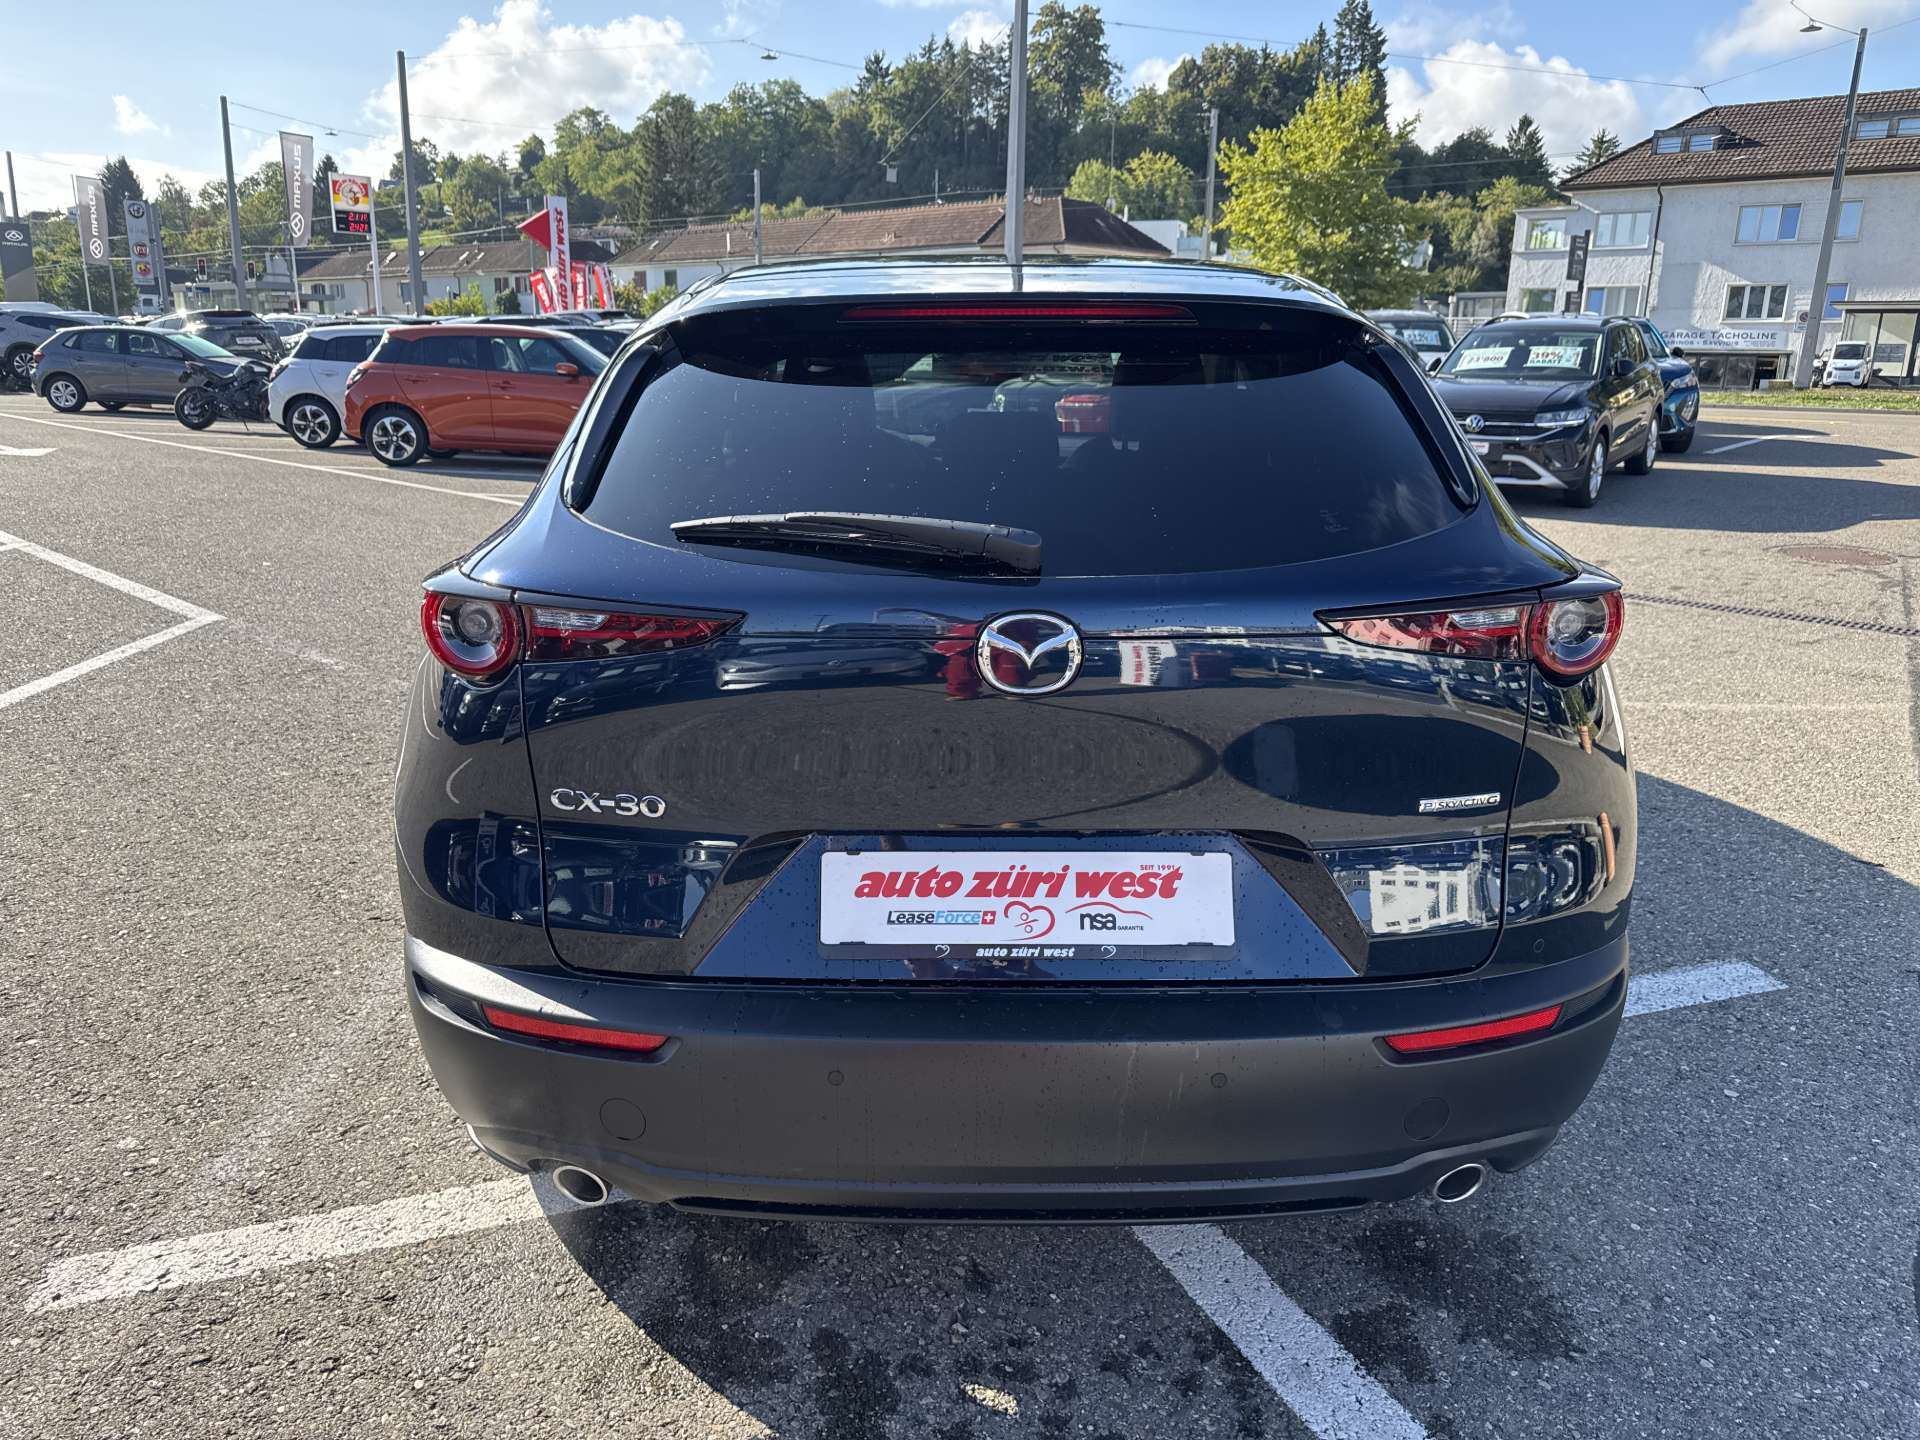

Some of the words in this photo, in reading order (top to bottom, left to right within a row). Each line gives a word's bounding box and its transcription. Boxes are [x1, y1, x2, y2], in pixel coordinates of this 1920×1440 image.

[292, 143, 302, 209] MAXUS
[87, 185, 99, 236] MAXUS
[1662, 331, 1706, 339] GARAGE
[1711, 330, 1778, 340] TACHOLINE
[550, 788, 666, 818] CX-30
[854, 864, 964, 898] auto
[964, 864, 1071, 898] züri
[1075, 866, 1183, 899] west
[887, 911, 981, 925] LeaseForce
[1079, 912, 1117, 931] nsa
[976, 947, 1008, 957] auto
[1010, 946, 1041, 957] züri
[1043, 947, 1075, 957] west
